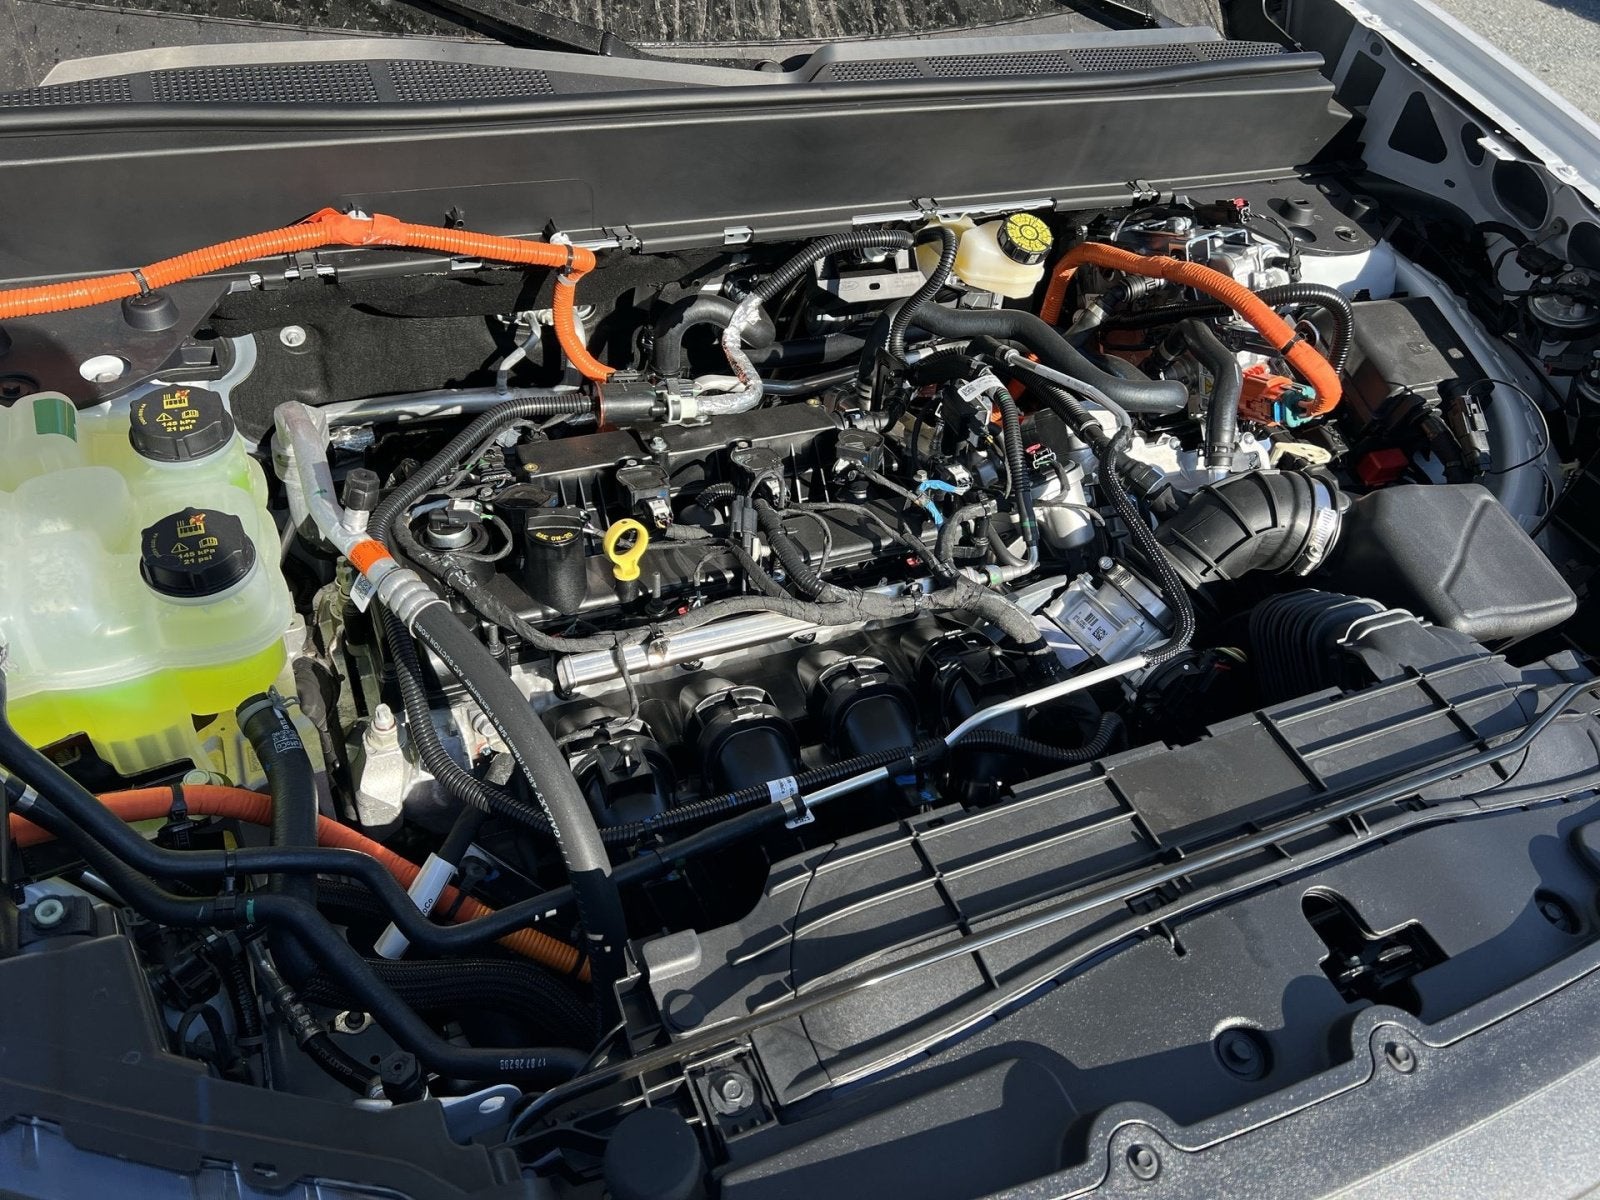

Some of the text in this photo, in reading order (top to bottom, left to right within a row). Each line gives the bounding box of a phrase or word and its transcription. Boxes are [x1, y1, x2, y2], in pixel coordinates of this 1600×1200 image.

[414, 621, 430, 640] HOSE
[429, 637, 454, 666] SUCTION
[535, 791, 561, 838] GALAXY
